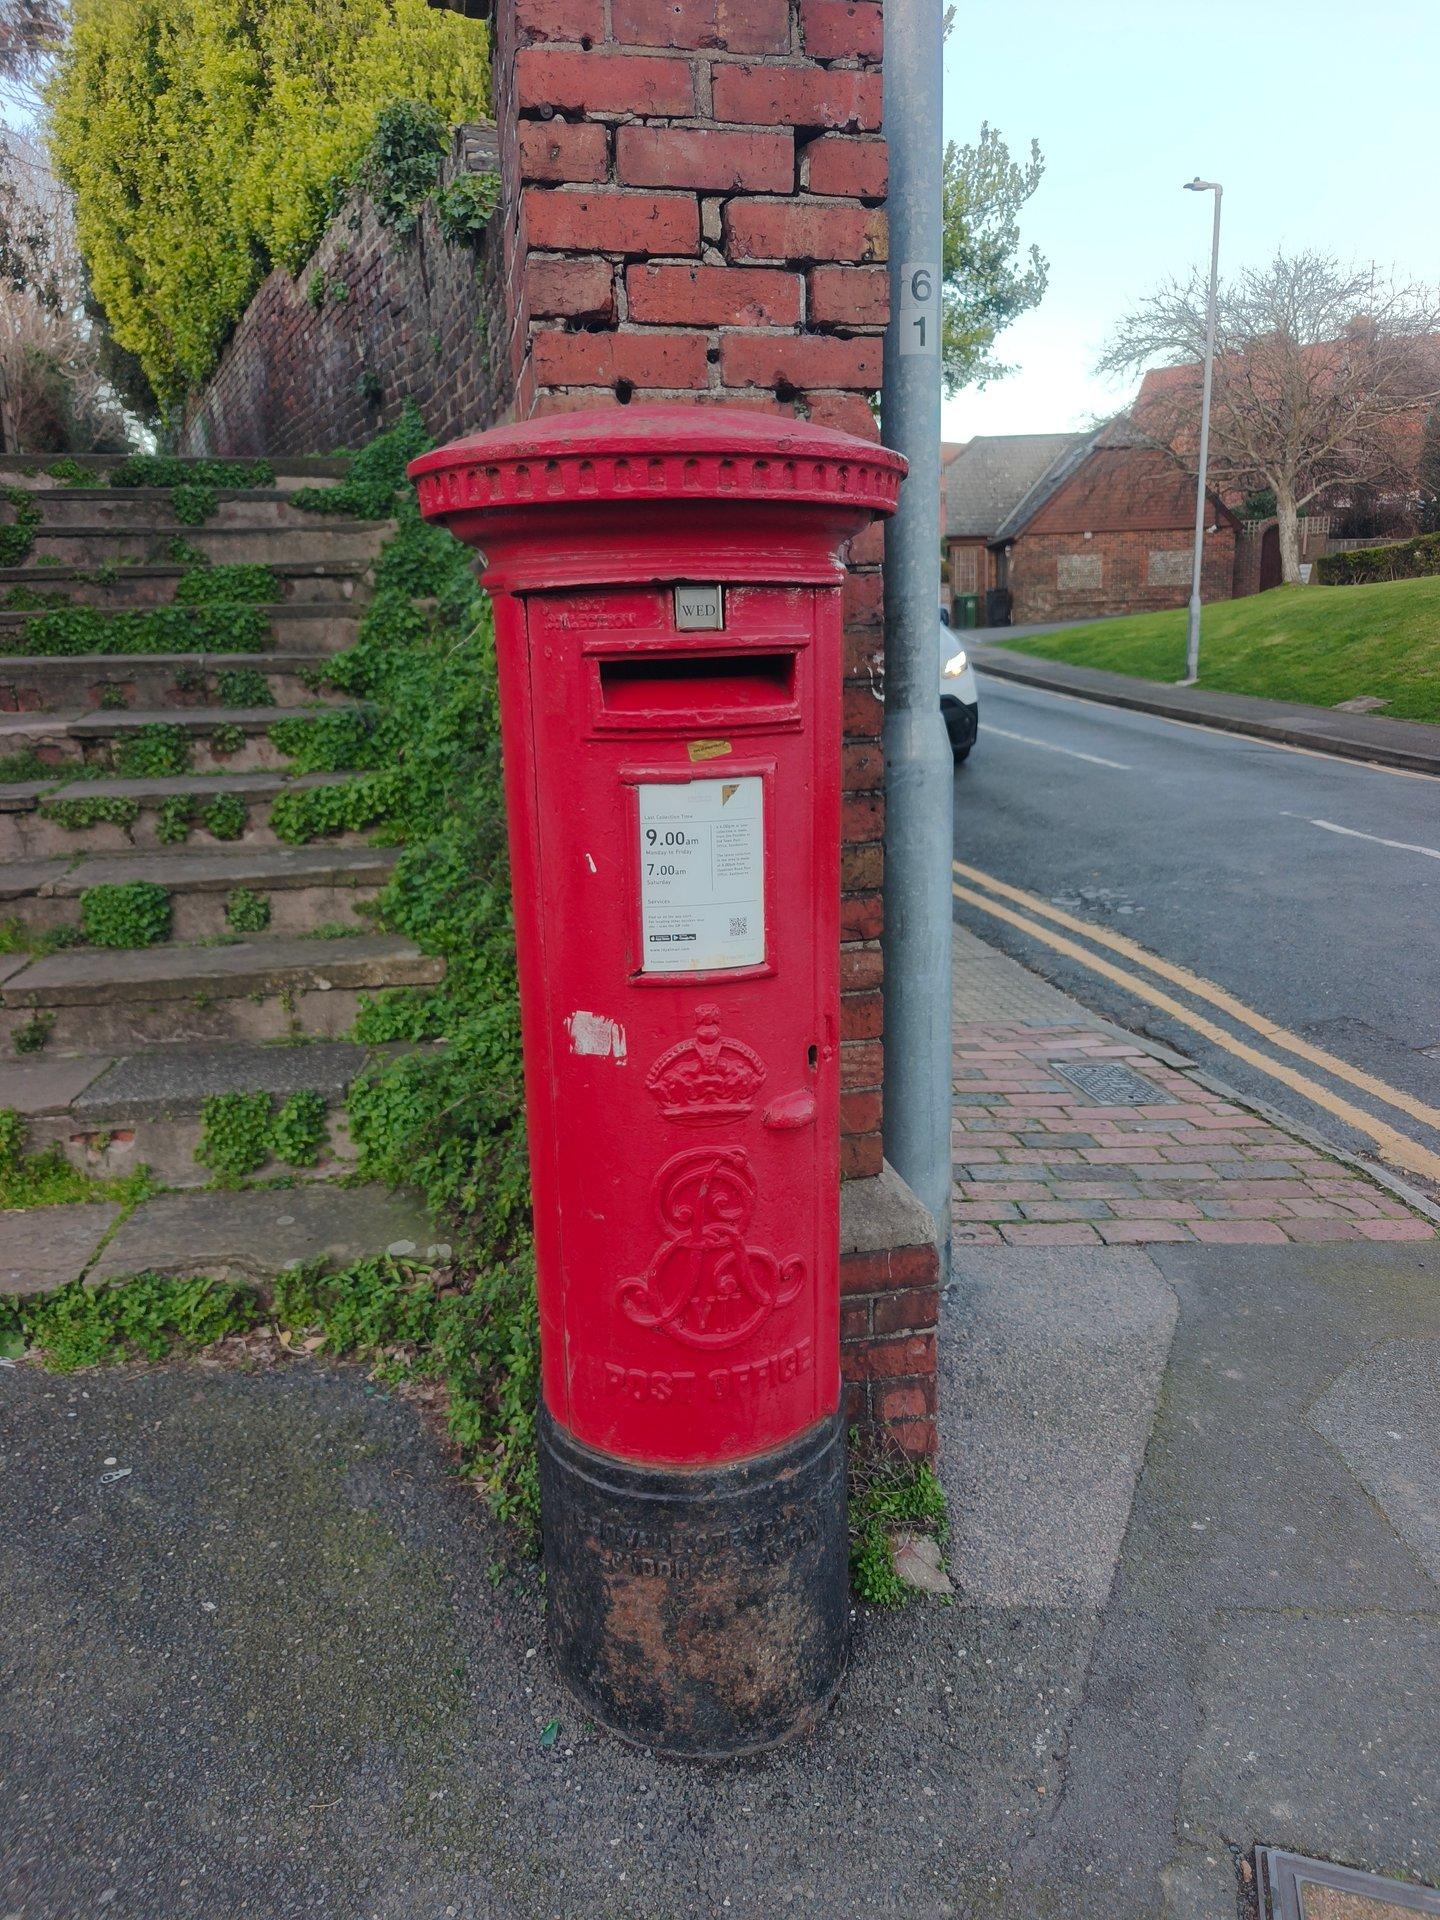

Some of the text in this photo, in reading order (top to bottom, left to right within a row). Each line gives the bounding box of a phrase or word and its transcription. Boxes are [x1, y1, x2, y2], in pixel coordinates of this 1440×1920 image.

[911, 269, 932, 302] 6
[913, 316, 926, 347] 1
[681, 604, 716, 617] WED
[645, 828, 699, 846] 9.00am
[646, 863, 687, 876] 7.00am
[603, 1336, 813, 1403] POST OFFICE
